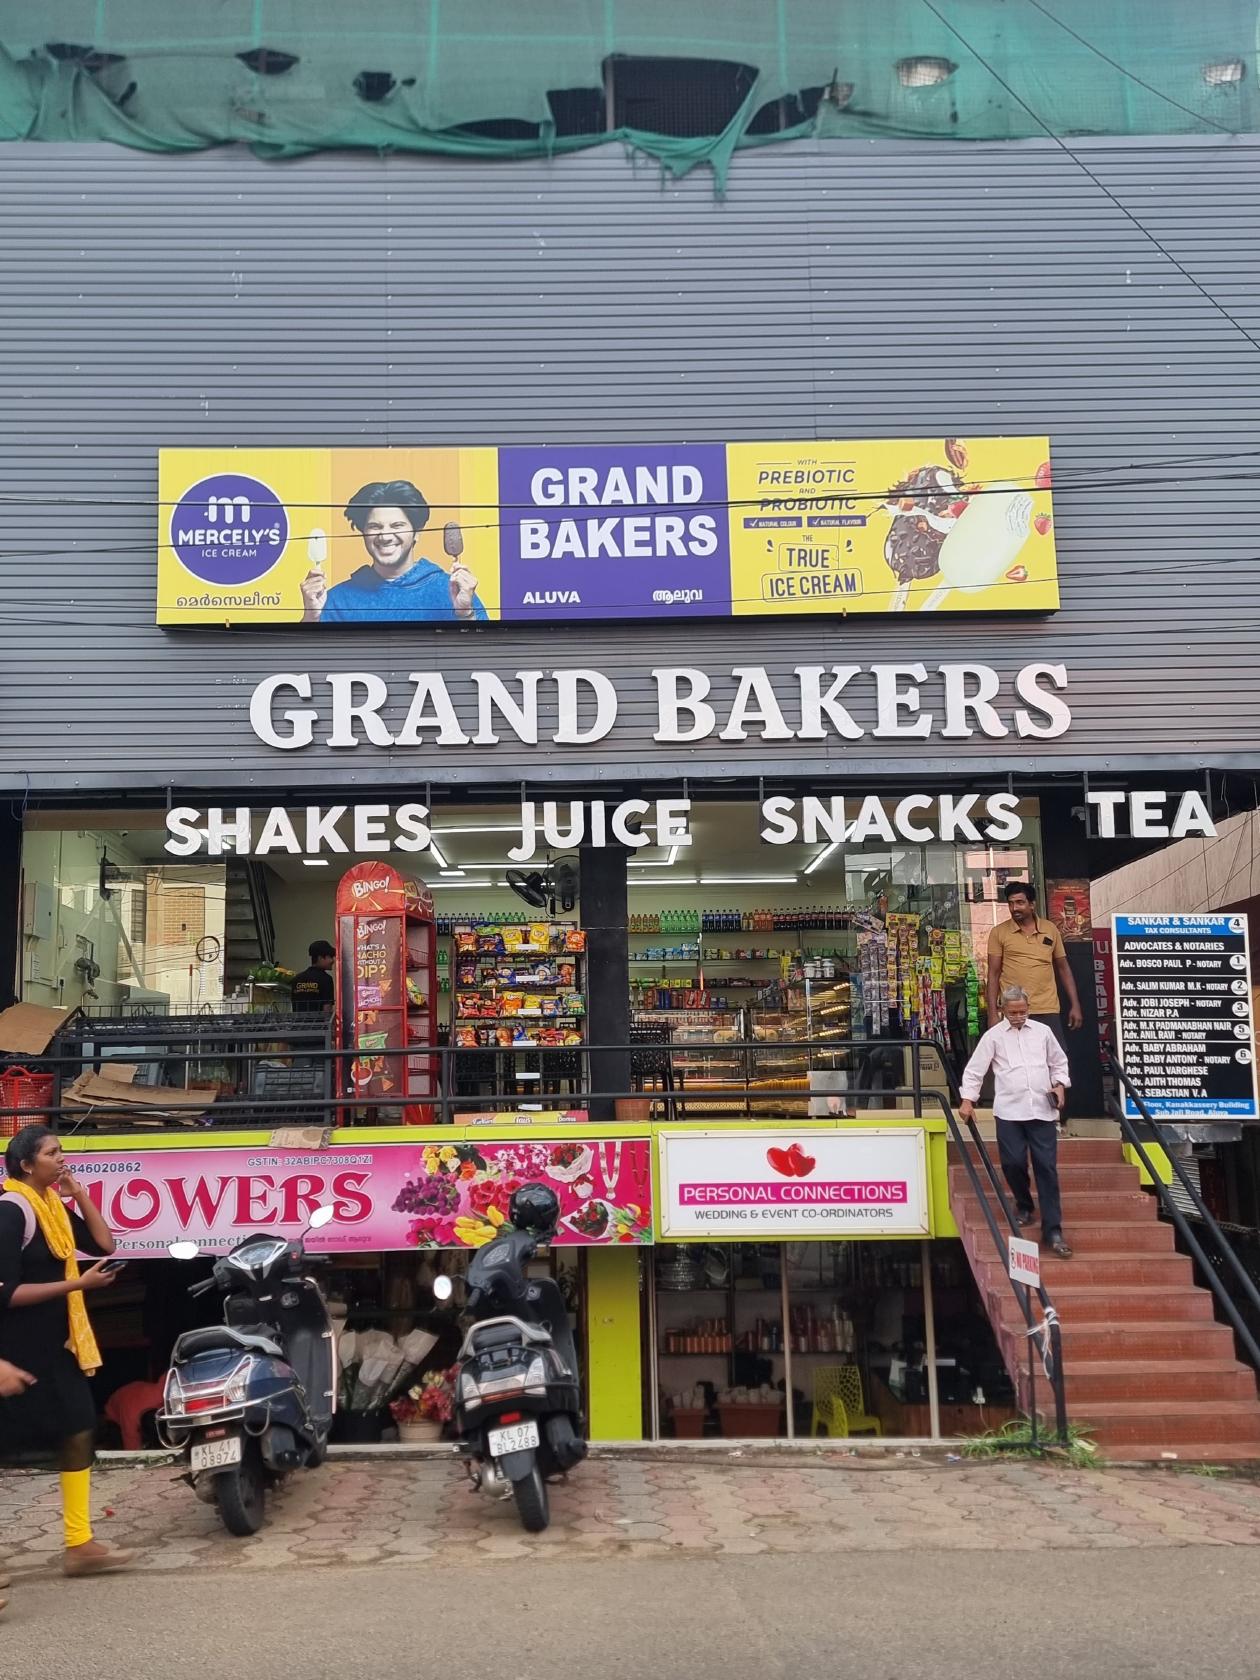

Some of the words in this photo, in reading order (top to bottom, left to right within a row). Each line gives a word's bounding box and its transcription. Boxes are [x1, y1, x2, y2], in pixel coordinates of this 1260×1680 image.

[758, 469, 855, 485] PREBIOTIC
[530, 465, 703, 507] GRAND
[760, 496, 857, 512] PROBIOTIC
[178, 528, 280, 546] MERCELY'S
[519, 514, 718, 559] BAKERS
[802, 534, 813, 543] THE
[202, 549, 217, 557] ICE
[221, 549, 257, 557] CREAM
[786, 548, 830, 568] TRUE
[769, 576, 795, 597] ICE
[799, 573, 857, 596] CREAM
[522, 591, 581, 604] ALUVA
[652, 589, 703, 605] ആലുവ
[249, 669, 619, 750] GRAND
[651, 662, 1072, 743] BAKERS
[759, 792, 1024, 846] SNACKS
[1086, 790, 1219, 839] TEA
[163, 803, 432, 857] SHAKES
[506, 798, 693, 862] JUICE
[353, 876, 390, 898] BINGO!
[1127, 917, 1170, 926] SANKAR
[1172, 917, 1181, 926] &
[1182, 917, 1225, 926] SANKAR
[1233, 919, 1240, 927] 4
[1124, 942, 1173, 951] ADVOCATES
[1174, 942, 1182, 951] &
[1183, 942, 1225, 951] NOTARIES
[1119, 959, 1135, 968] Adv.
[1136, 959, 1162, 968] BOSCO
[1163, 959, 1183, 968] PAUL
[1197, 960, 1222, 968] NOTARY
[1121, 982, 1136, 991] Adv.
[1136, 982, 1159, 991] SALIM
[1159, 982, 1186, 991] KUMAR
[1206, 983, 1228, 991] NOTARY
[1236, 981, 1243, 989] 2
[1122, 999, 1139, 1007] Adv.
[1140, 999, 1159, 1007] JOBI
[1159, 999, 1190, 1007] JOSEPH
[1196, 1000, 1222, 1008] NOTARY
[1122, 1009, 1139, 1017] Adv.
[1140, 1009, 1165, 1017] NIZAR
[1123, 1022, 1139, 1030] Adv.
[1155, 1022, 1212, 1031] PADMANABHAN
[1213, 1022, 1232, 1031] NAIR
[1123, 1031, 1139, 1040] Adv.
[1140, 1031, 1158, 1040] ANIL
[1158, 1031, 1176, 1040] RAVI
[1182, 1032, 1207, 1040] NOTARY
[1124, 1044, 1141, 1053] Adv.
[1142, 1044, 1164, 1053] BABY
[1165, 1044, 1207, 1053] ABRAHAM
[1125, 1055, 1142, 1064] Adv.
[1142, 1055, 1166, 1064] BABY
[1166, 1055, 1198, 1064] ANTONY
[1203, 1056, 1231, 1064] NOTARY
[1126, 1066, 1142, 1075] Adv.
[1143, 1066, 1165, 1075] PAUL
[1165, 1066, 1209, 1075] VARGHESE
[1144, 1077, 1166, 1086] AJITH
[1167, 1077, 1201, 1086] THOMAS
[1145, 1088, 1190, 1097] SEBASTIAN
[1219, 1102, 1250, 1110] Building
[683, 1185, 777, 1202] PERSONAL
[780, 1184, 904, 1201] CONNECTIONS
[694, 1210, 747, 1220] WEDDING
[750, 1209, 758, 1219] &
[761, 1209, 799, 1219] EVENT
[801, 1208, 894, 1218] CO-ORDINATORS
